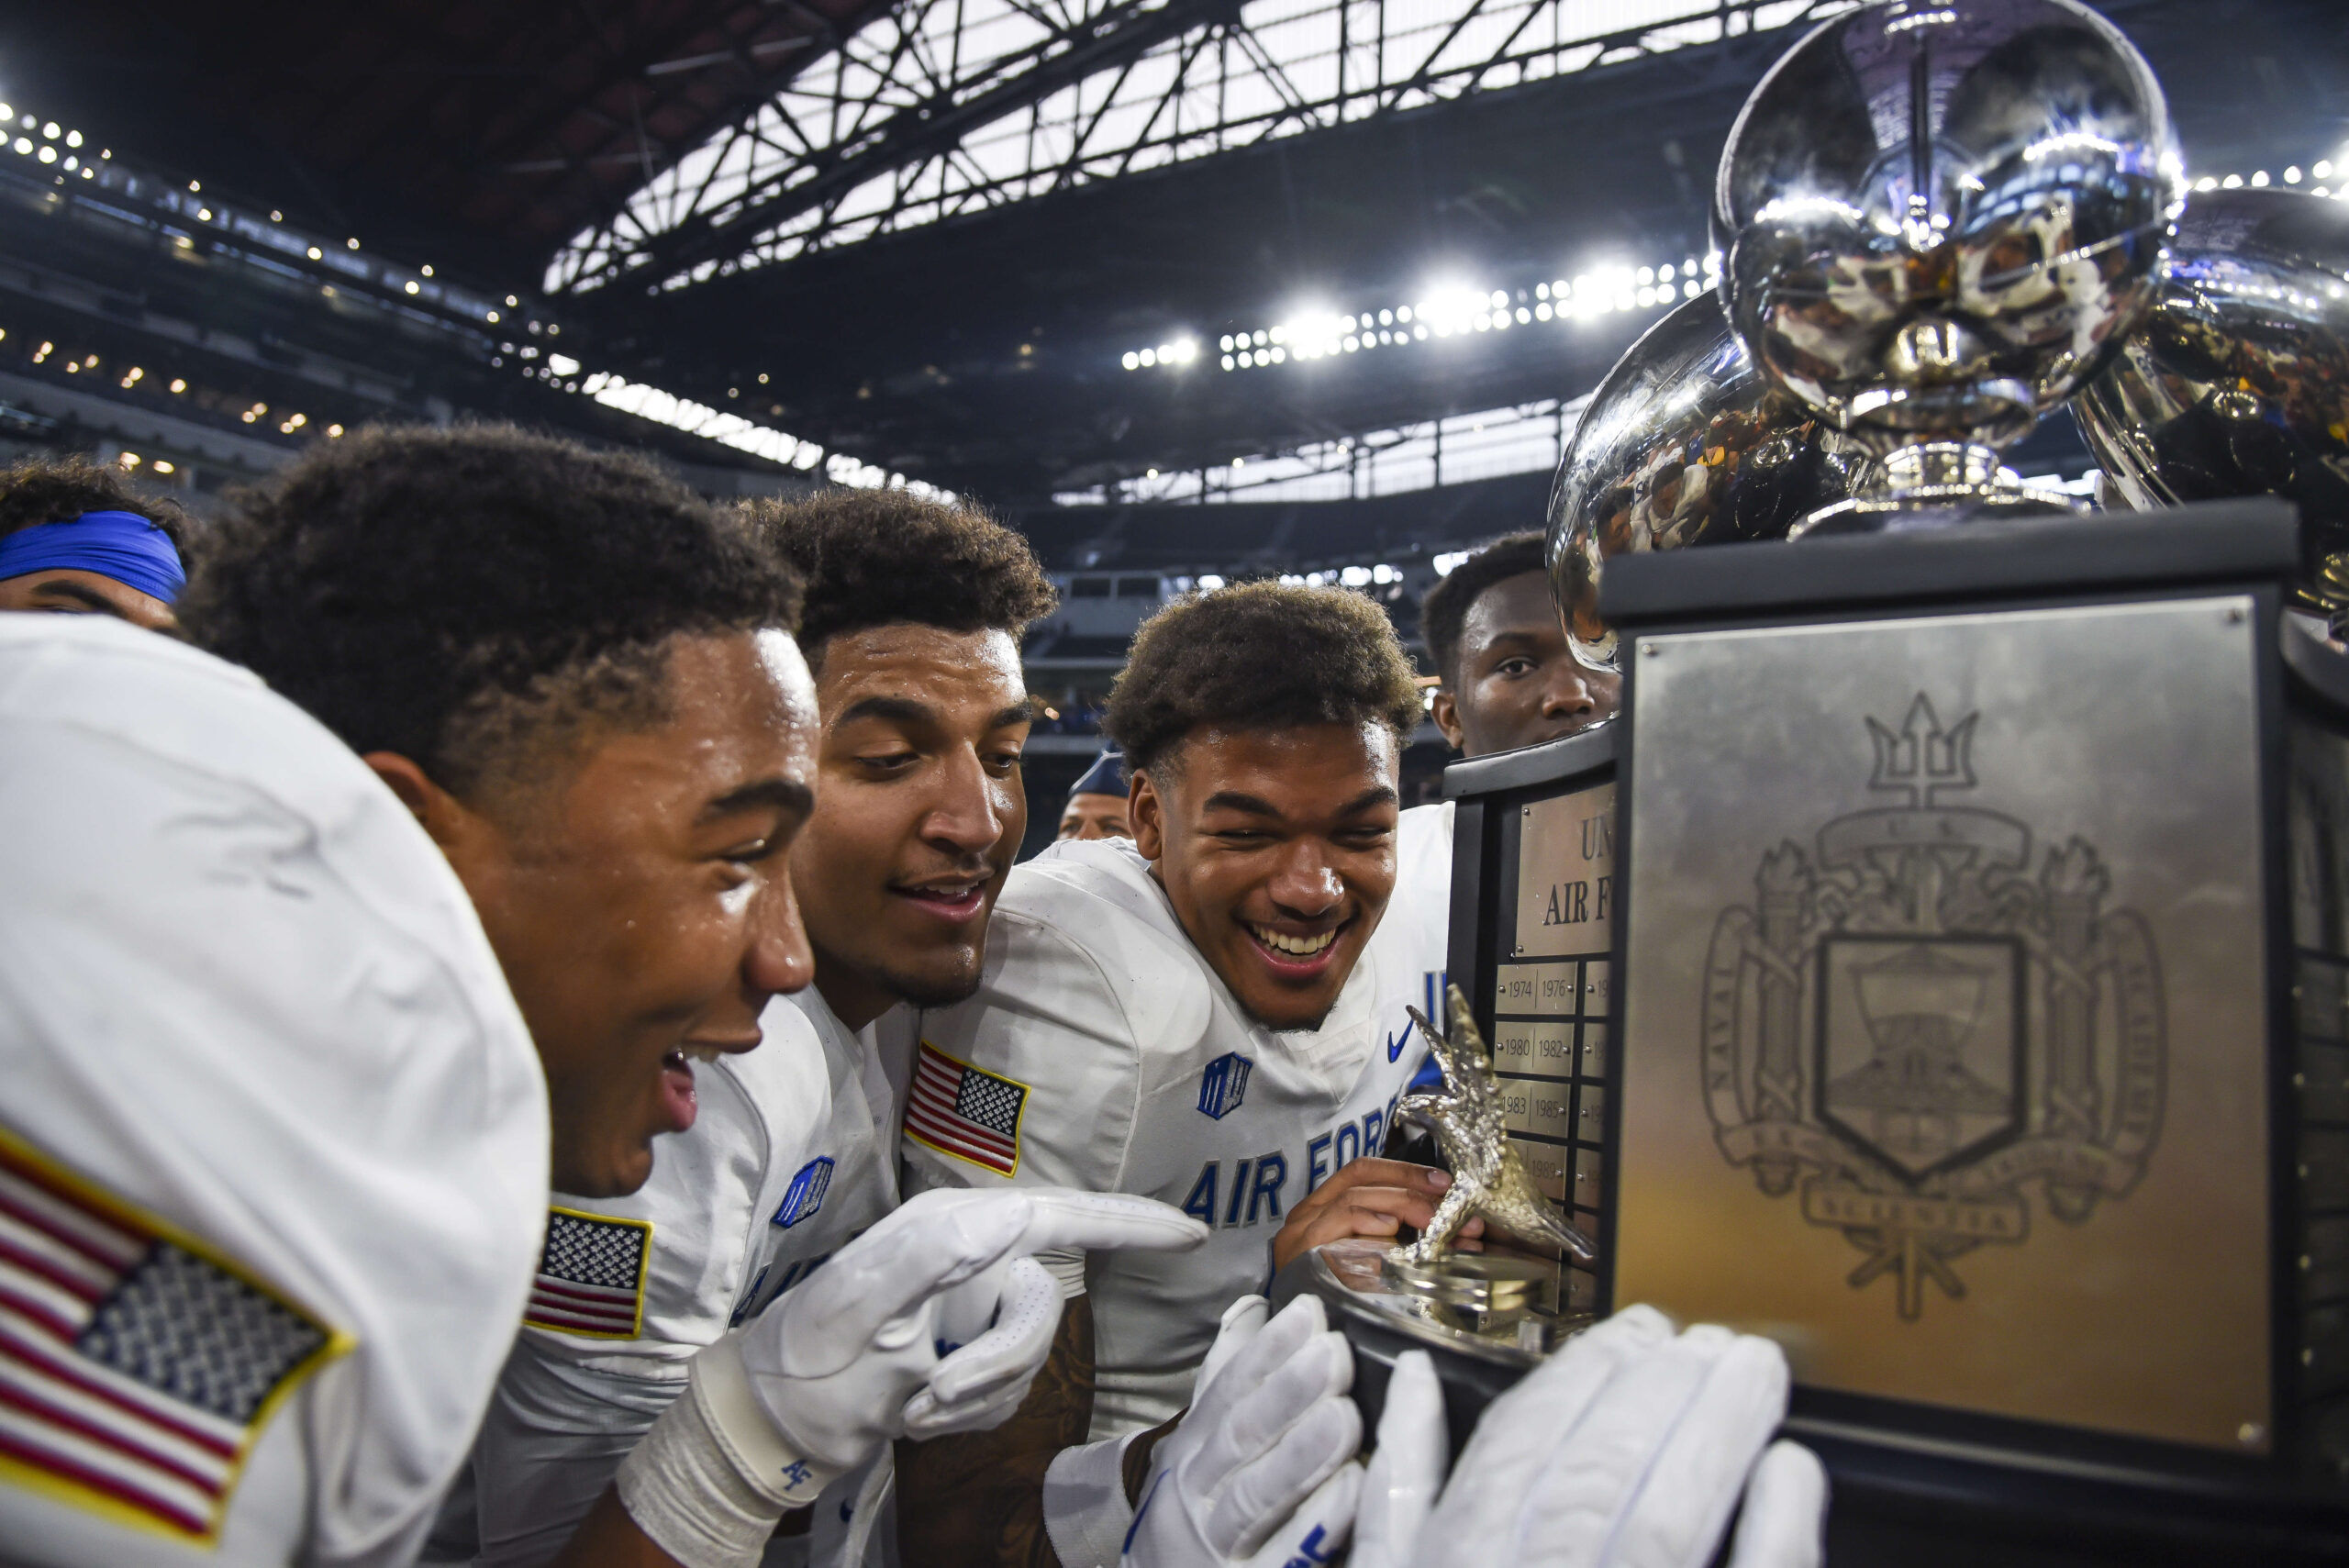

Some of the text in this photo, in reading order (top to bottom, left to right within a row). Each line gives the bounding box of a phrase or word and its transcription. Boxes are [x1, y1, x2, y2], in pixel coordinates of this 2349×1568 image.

[1543, 880, 1588, 926] AIR
[1509, 979, 1566, 998] 1974 1976
[1506, 1039, 1563, 1058] 1980 1982
[1502, 1095, 1559, 1118] 1983 1985
[1531, 1159, 1556, 1180] 1989
[1180, 1149, 1288, 1229] AIR
